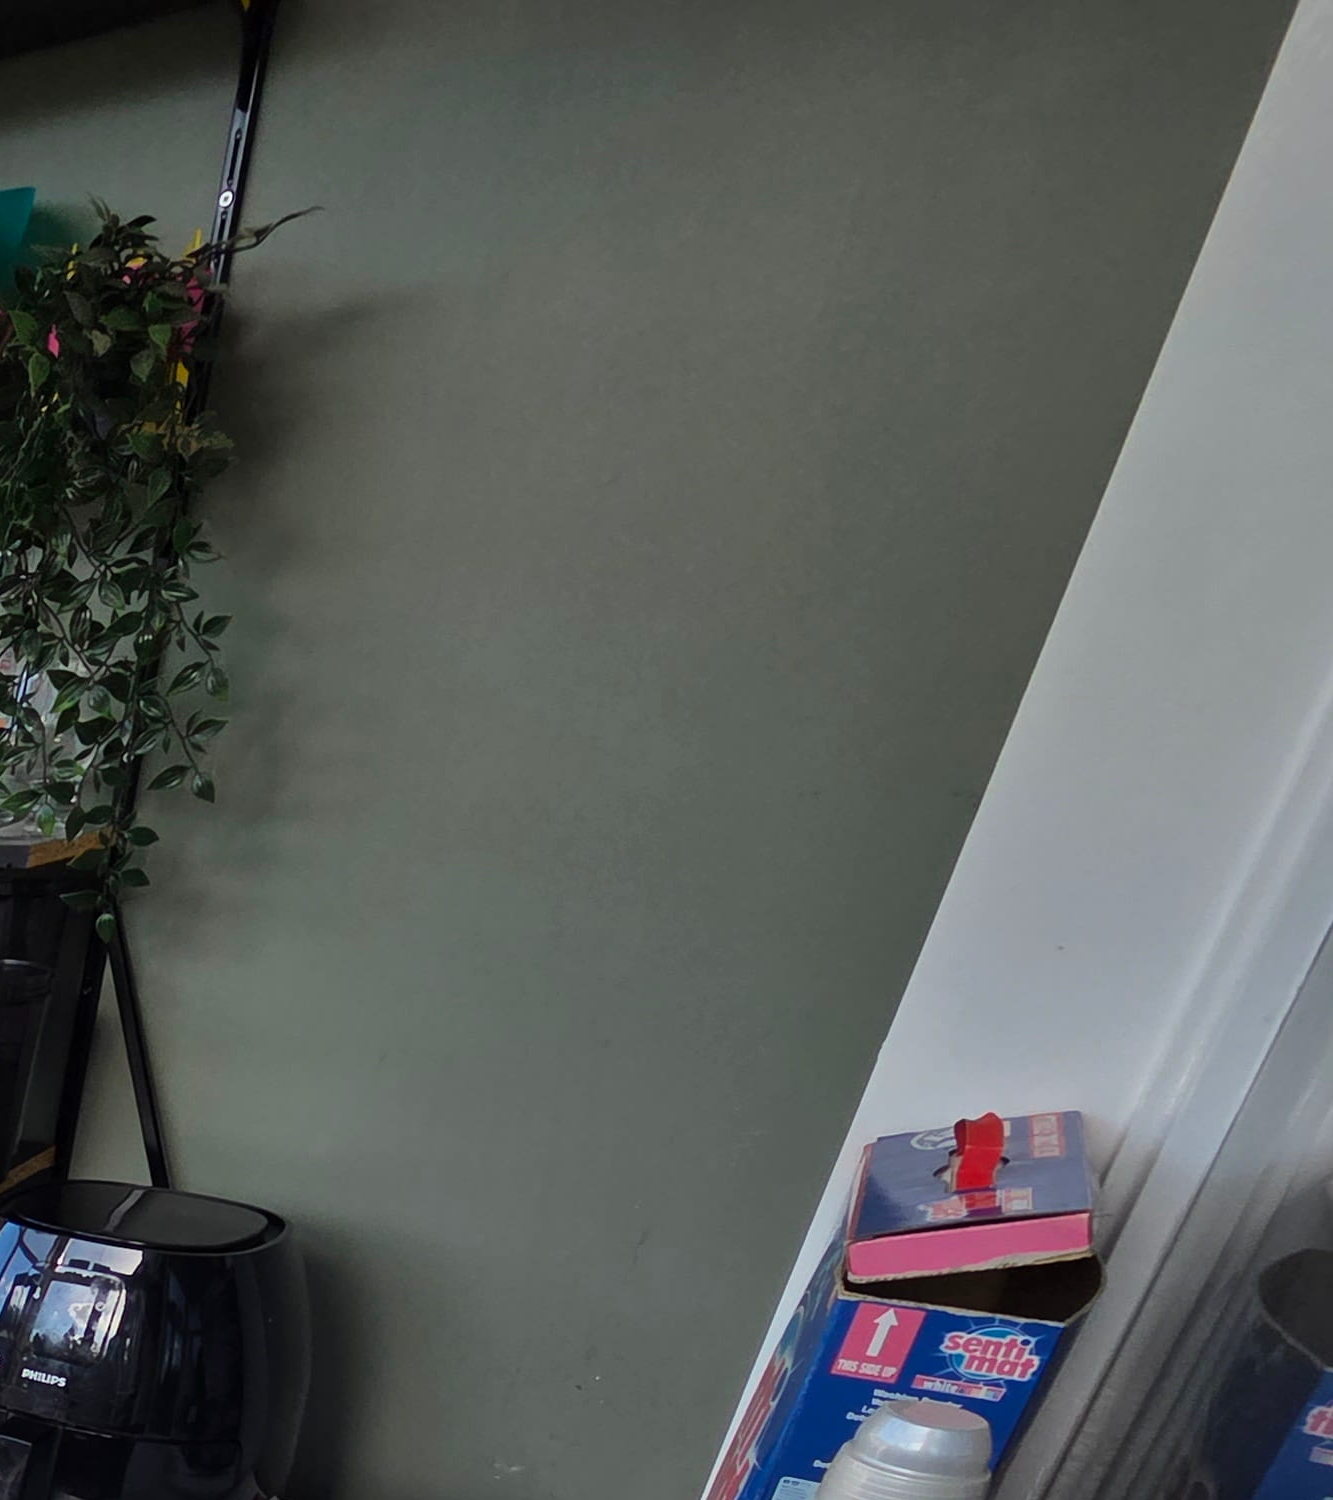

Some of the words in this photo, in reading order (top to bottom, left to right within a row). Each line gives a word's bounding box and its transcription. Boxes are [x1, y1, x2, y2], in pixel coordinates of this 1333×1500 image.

[939, 1331, 1034, 1363] senti
[21, 1368, 68, 1388] PHILIPS
[835, 1358, 858, 1372] THIS
[859, 1362, 882, 1376] SIDE
[882, 1366, 899, 1379] UP
[962, 1352, 1041, 1382] mat
